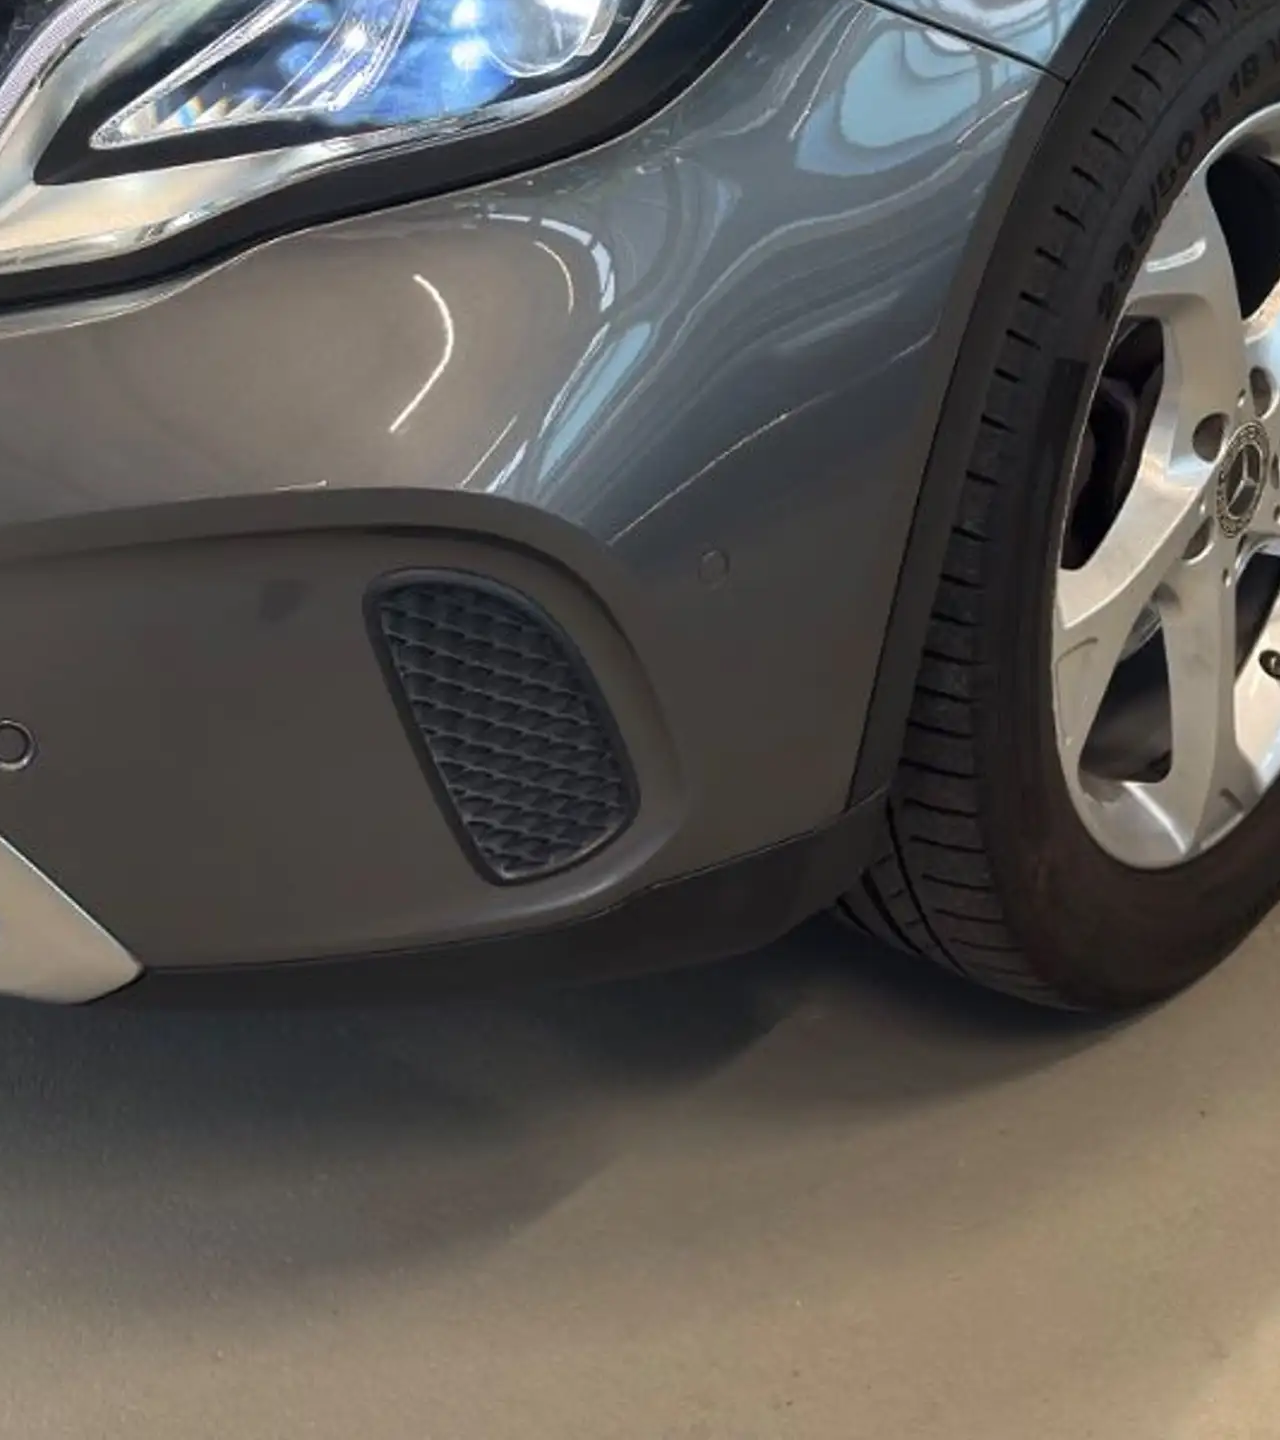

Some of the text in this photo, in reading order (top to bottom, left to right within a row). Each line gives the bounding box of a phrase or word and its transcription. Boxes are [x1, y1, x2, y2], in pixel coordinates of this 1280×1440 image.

[1097, 130, 1196, 323] 235/50
[1200, 91, 1222, 130] R
[1229, 52, 1260, 98] 18
